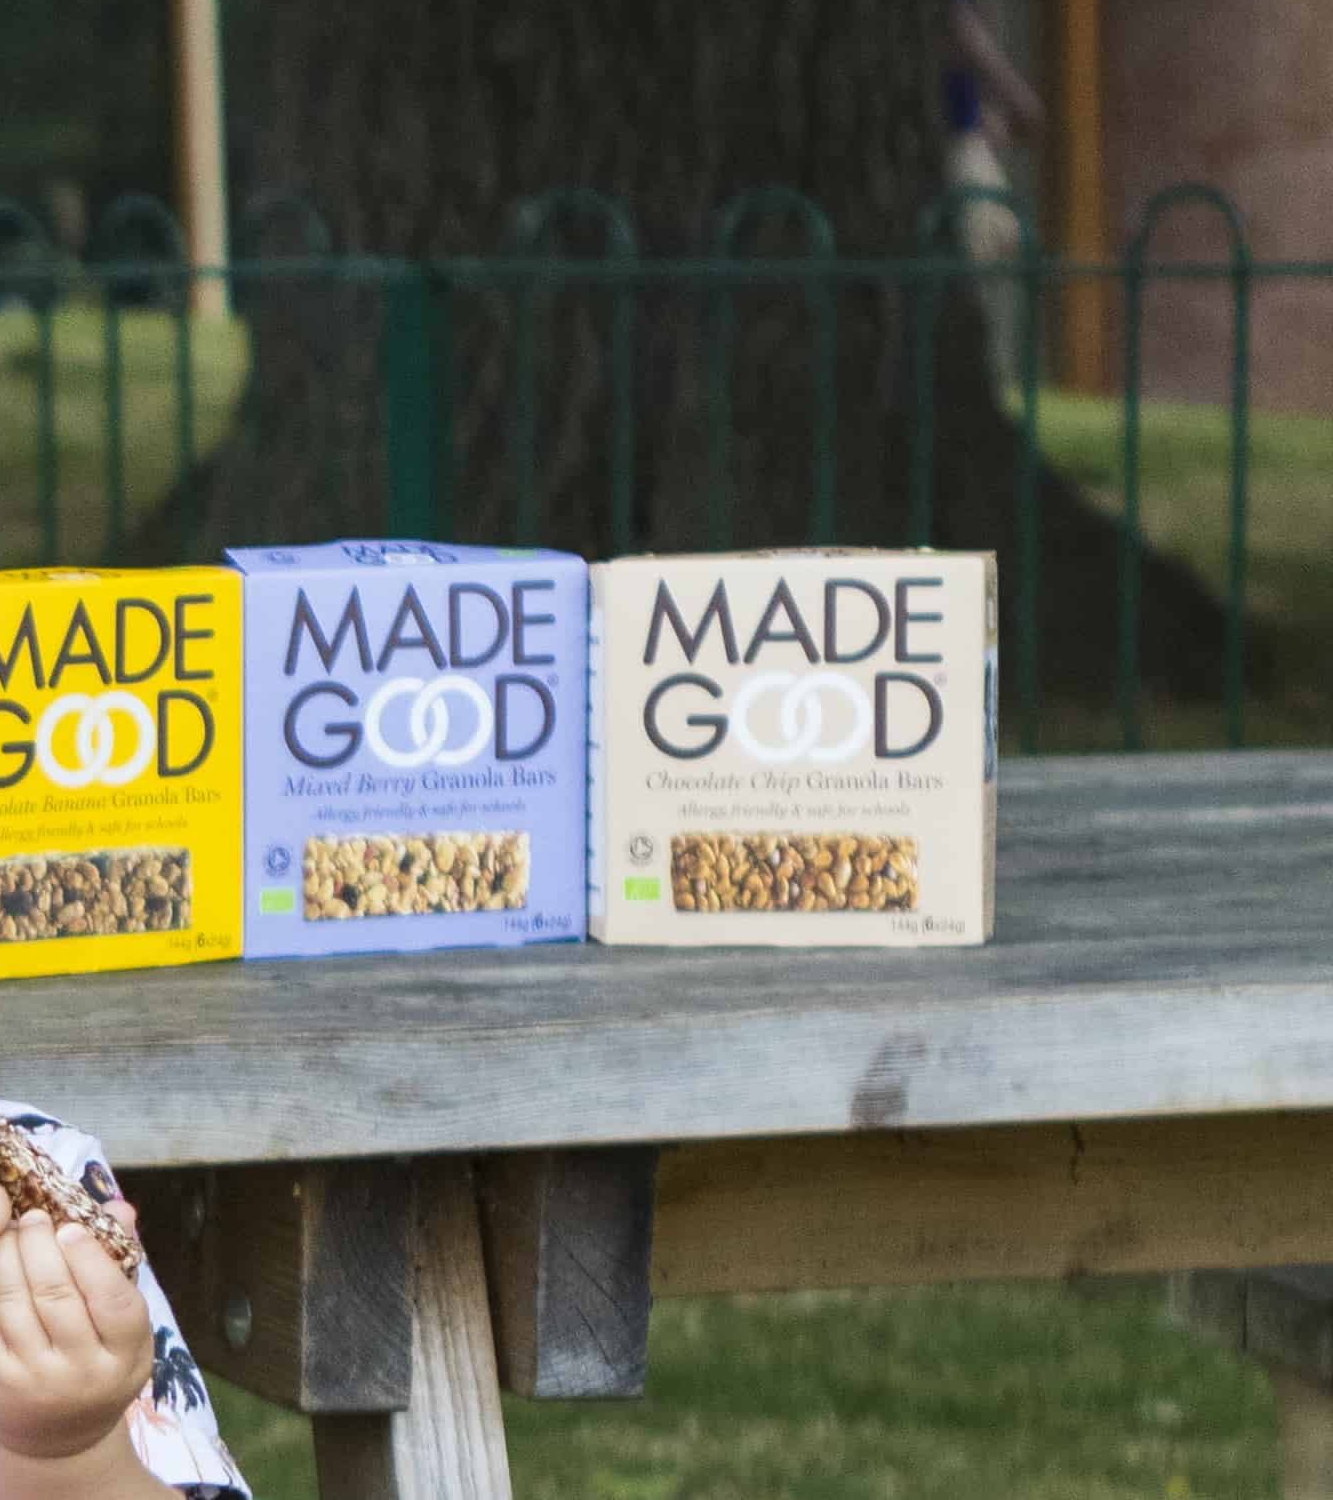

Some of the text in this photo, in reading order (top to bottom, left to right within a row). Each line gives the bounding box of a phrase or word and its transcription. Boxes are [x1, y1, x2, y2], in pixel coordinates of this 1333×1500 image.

[284, 580, 555, 676] MADE
[643, 577, 943, 665] MADE
[284, 673, 556, 769] GOOD
[643, 671, 944, 761] GOOD
[43, 795, 108, 813] Banana
[112, 788, 179, 809] Granola
[185, 787, 222, 805] Bars
[284, 765, 557, 797] Mixed Berry Granola Bars
[646, 769, 944, 794] Chocolate Chip Granola Bars
